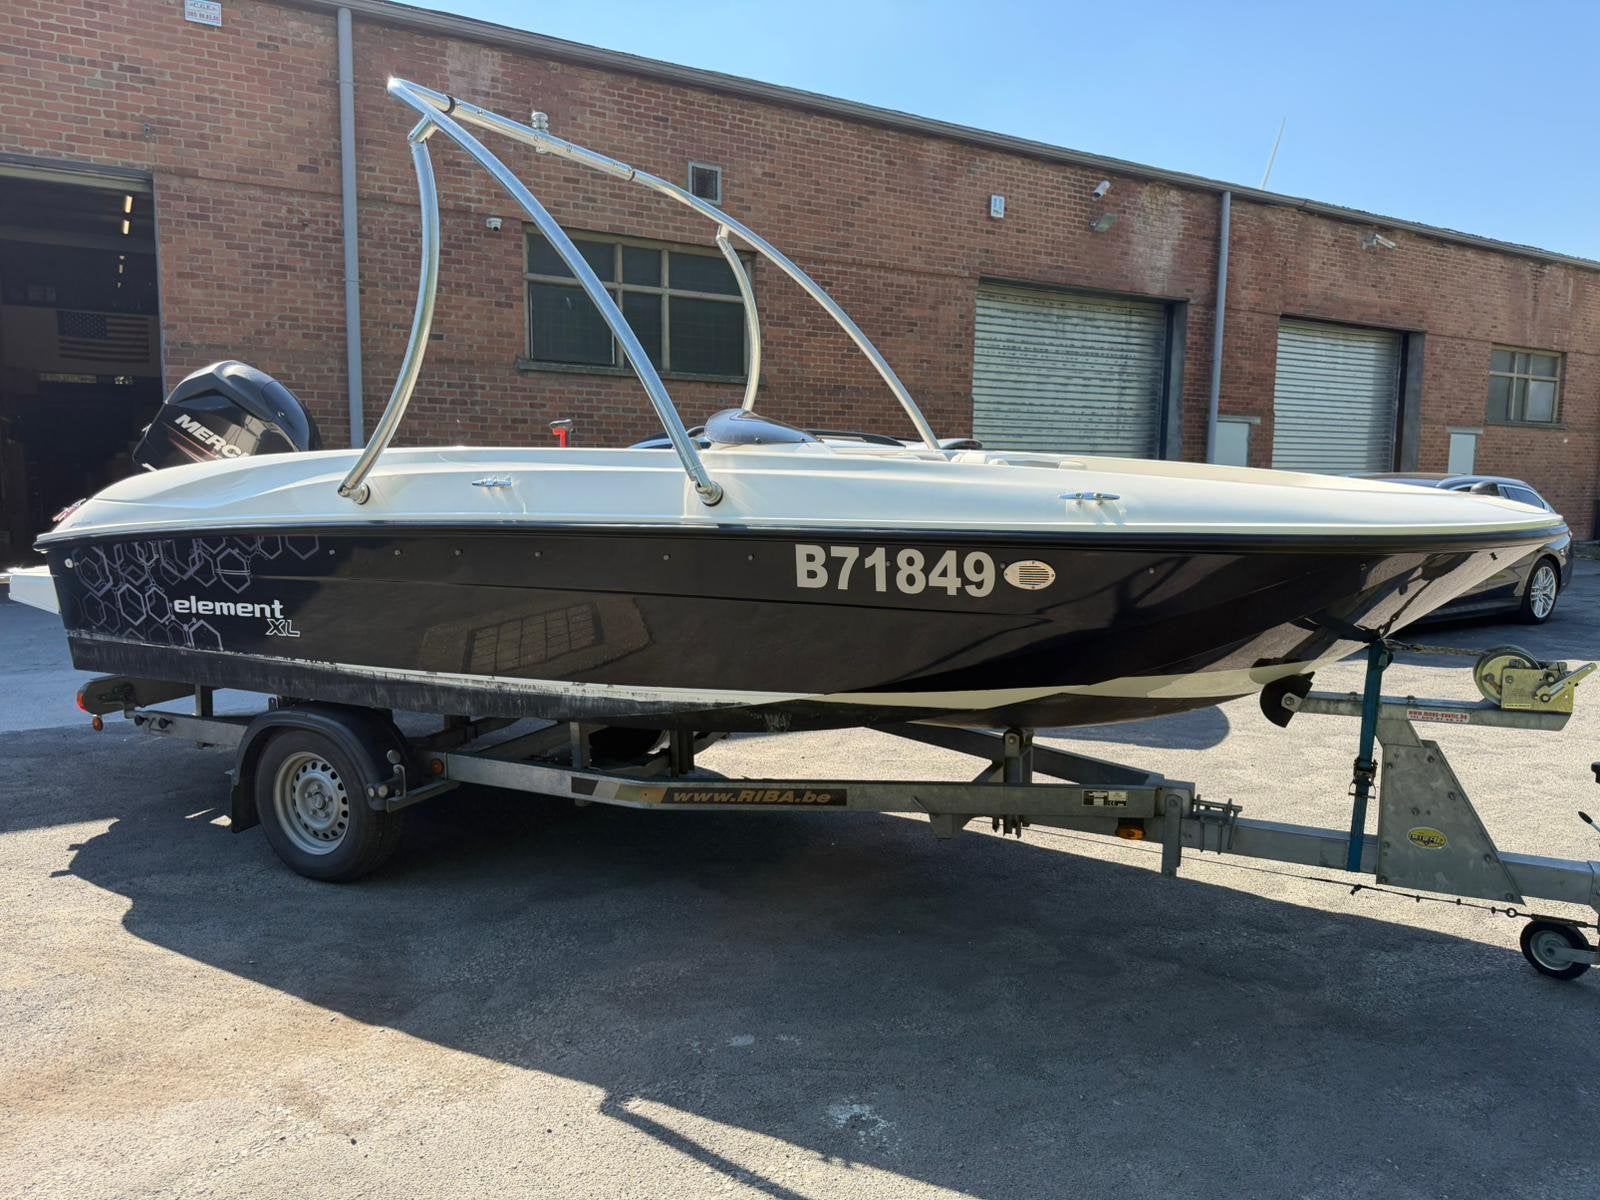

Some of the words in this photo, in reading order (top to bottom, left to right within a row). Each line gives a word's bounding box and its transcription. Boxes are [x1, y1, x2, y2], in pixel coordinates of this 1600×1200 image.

[174, 414, 250, 458] MERC
[795, 544, 996, 598] B71849
[173, 595, 284, 619] element
[265, 618, 300, 637] XL
[673, 790, 832, 804] www.RIBA.be
